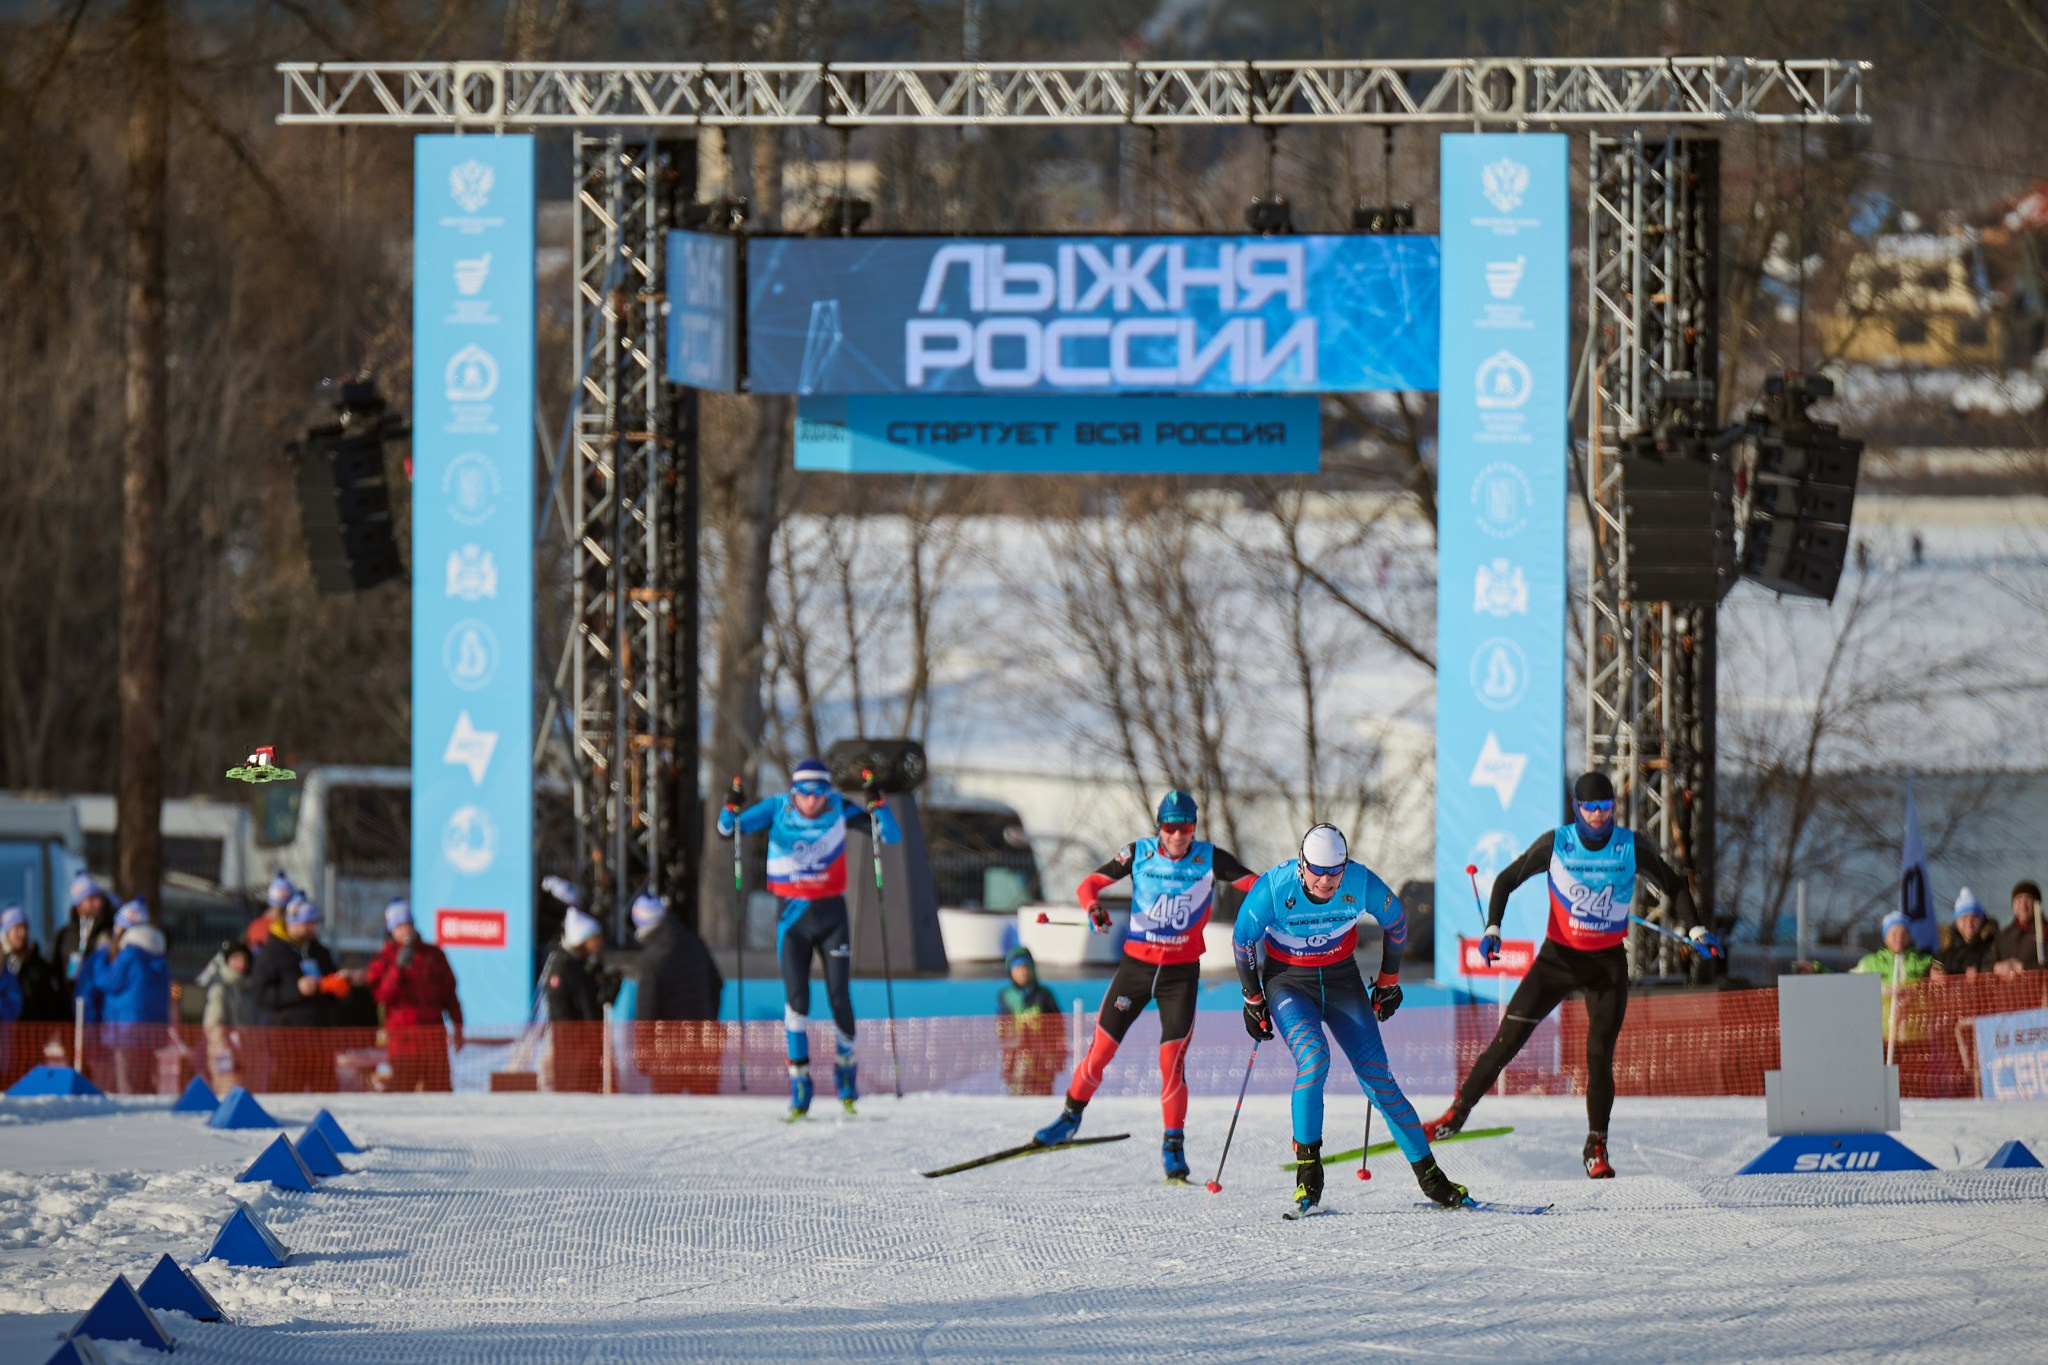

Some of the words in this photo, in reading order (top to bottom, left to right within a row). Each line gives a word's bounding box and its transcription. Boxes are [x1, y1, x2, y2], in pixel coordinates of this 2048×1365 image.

[918, 244, 1305, 312] ЛЫЖНЯ
[906, 318, 1317, 387] РОССИИ
[886, 421, 1059, 446] СТАРТУЕТ
[1075, 421, 1141, 446] ВСЯ
[1156, 421, 1287, 446] РОССИЯ
[1148, 892, 1192, 931] 45
[1569, 883, 1614, 918] 24
[1305, 933, 1331, 948] 6
